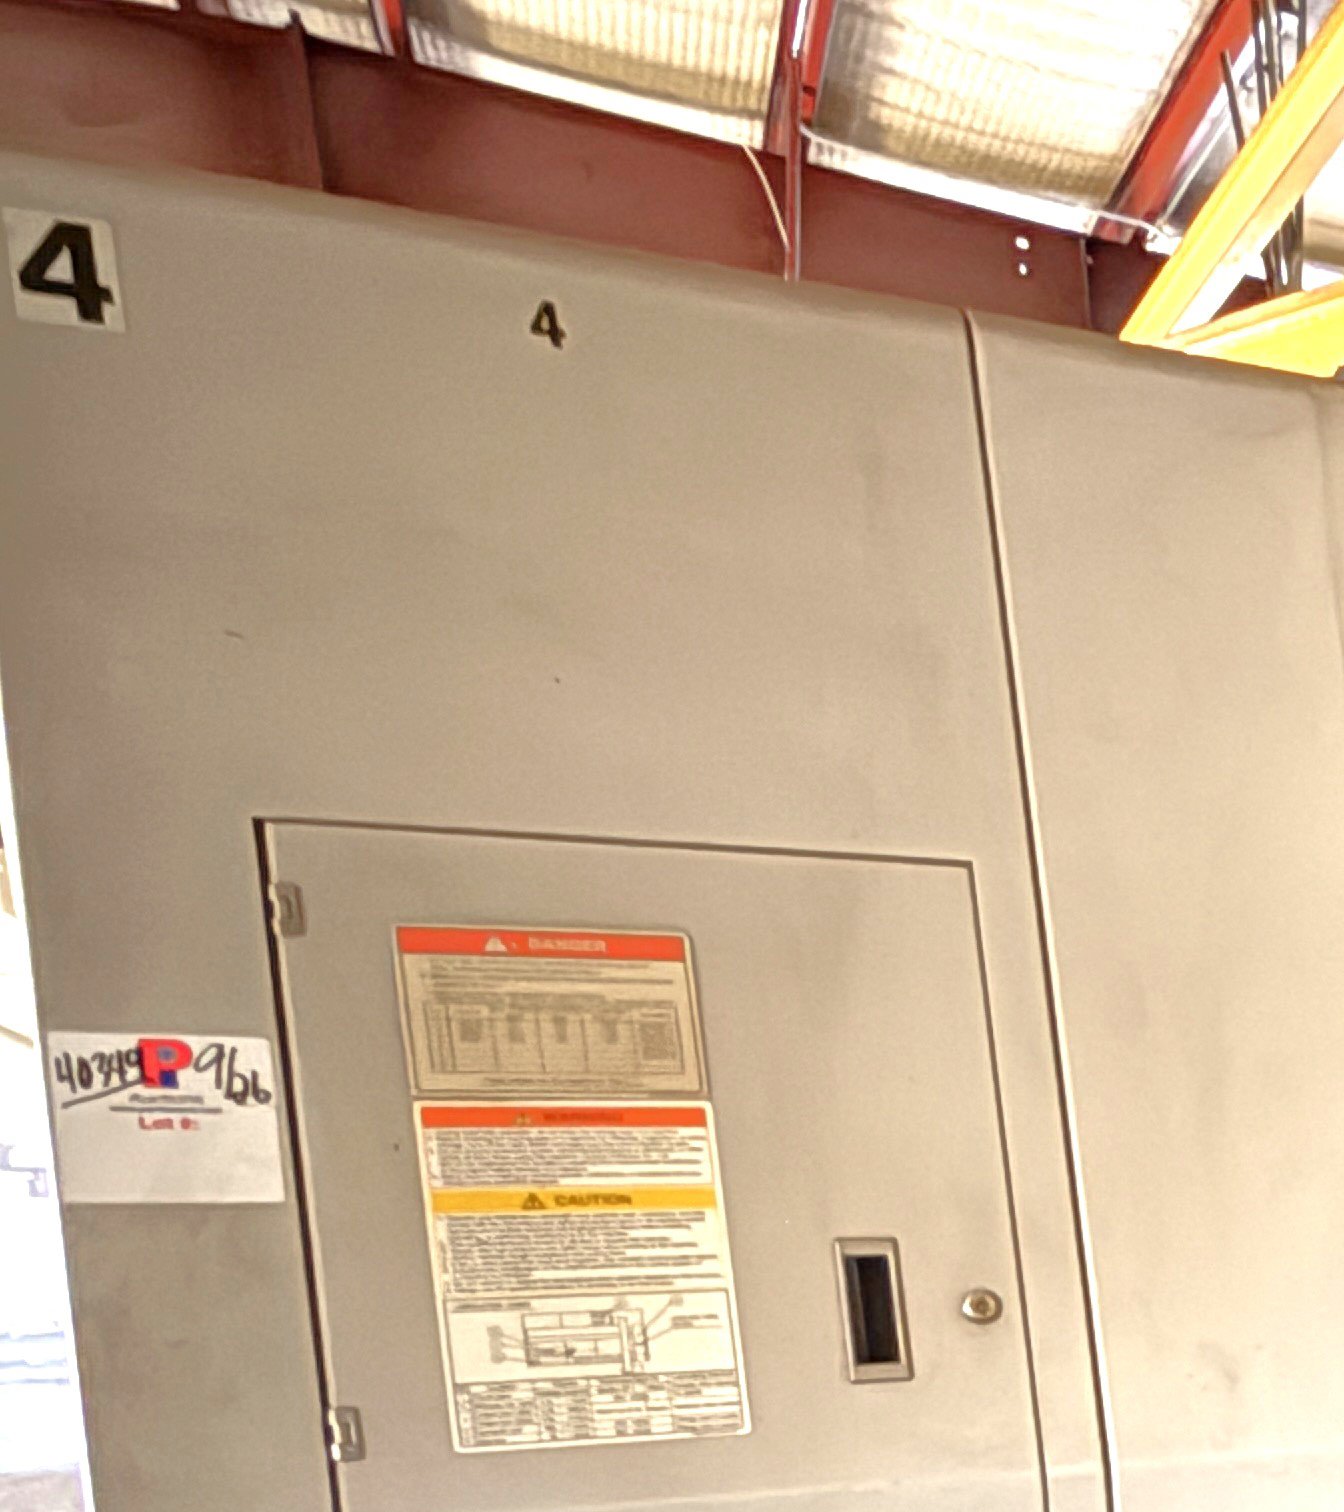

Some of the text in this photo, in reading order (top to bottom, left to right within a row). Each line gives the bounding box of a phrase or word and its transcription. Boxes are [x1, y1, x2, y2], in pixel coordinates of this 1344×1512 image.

[18, 219, 114, 324] 4
[529, 300, 567, 350] 4
[553, 1192, 633, 1207] CAUTION
